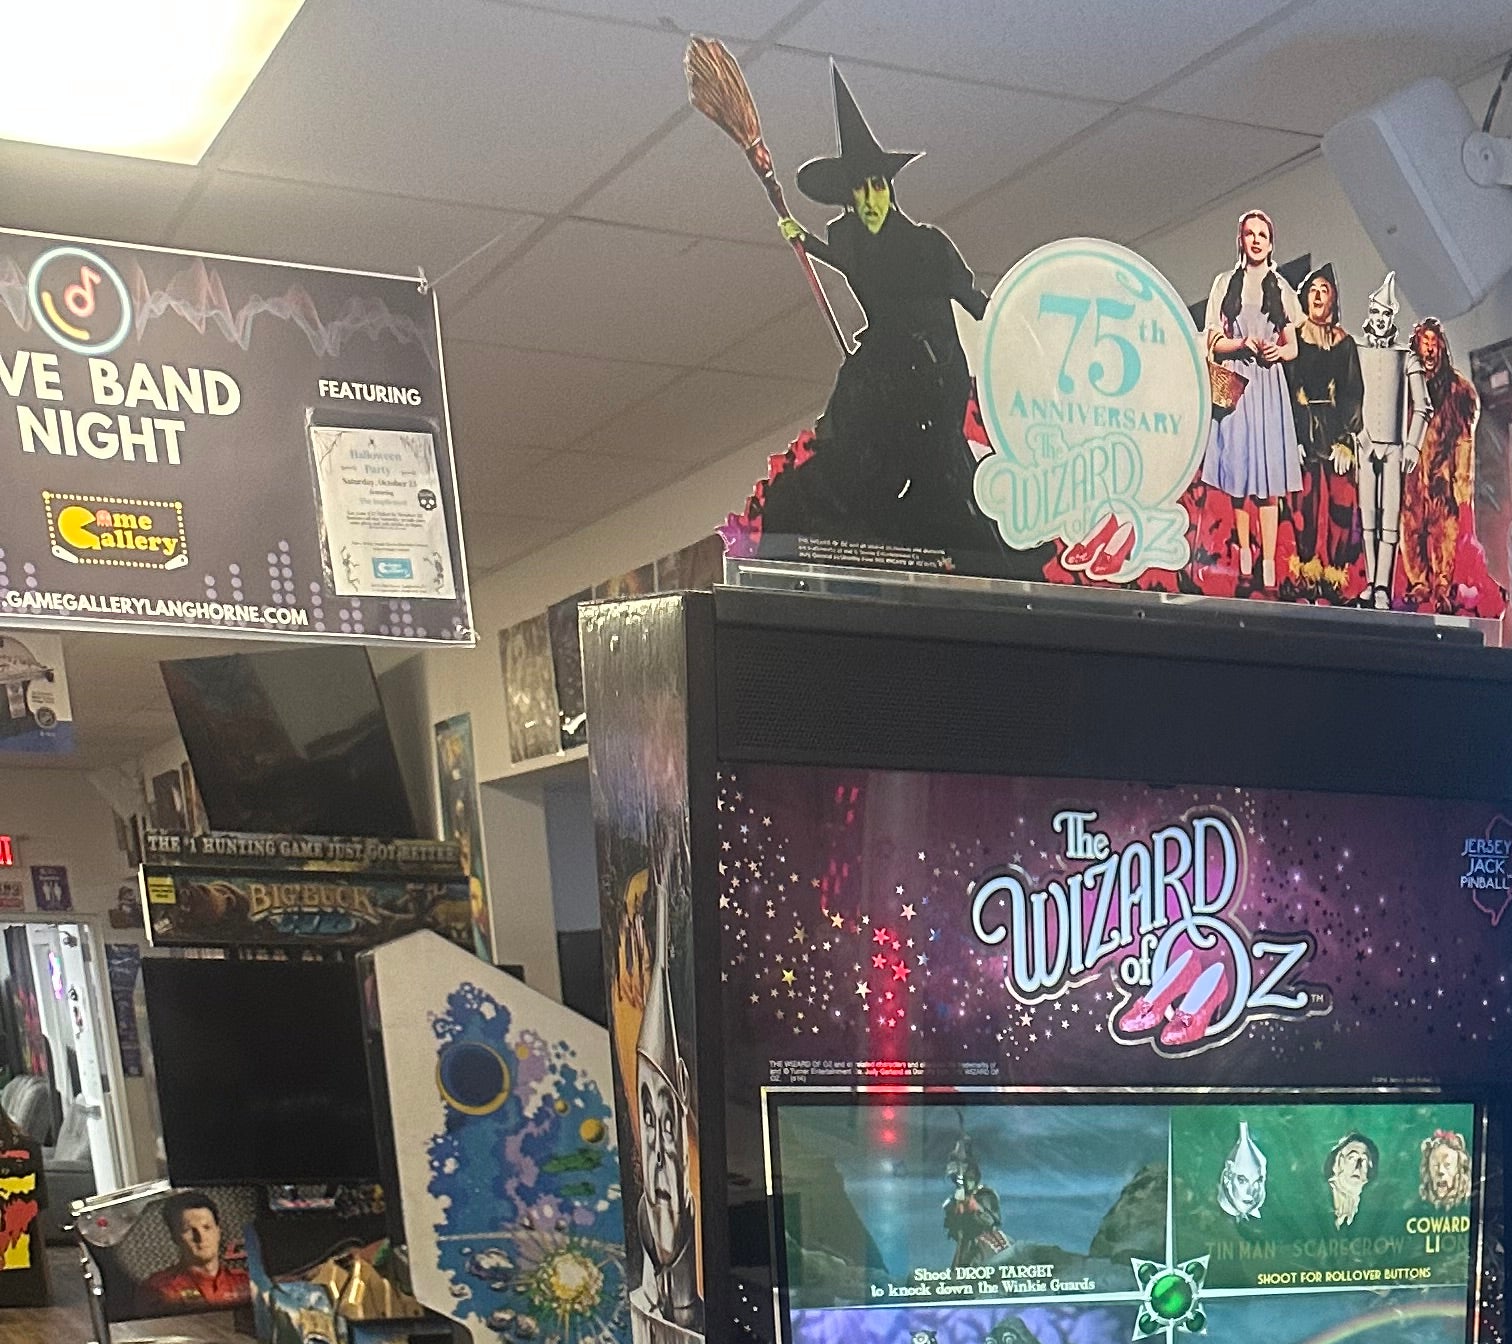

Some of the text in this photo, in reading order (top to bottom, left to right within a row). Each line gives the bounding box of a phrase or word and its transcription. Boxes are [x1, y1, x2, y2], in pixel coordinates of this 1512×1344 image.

[1038, 293, 1167, 398] 75th
[89, 358, 241, 416] BAND
[318, 379, 422, 406] FEATURING
[1010, 389, 1183, 435] ANNIVERSARY
[17, 406, 186, 465] NIGHT
[989, 444, 1137, 533] WIZARD
[6, 590, 309, 627] GAMEGALLERYLANGHORNE.COM
[148, 835, 181, 852] THE
[201, 837, 276, 857] HUNTING
[280, 840, 321, 858] GAME
[327, 842, 363, 859] JUST
[1052, 811, 1111, 860] The
[1460, 838, 1512, 857] JERSEY
[1466, 857, 1506, 877] JACK
[1460, 875, 1510, 890] PINBALL
[249, 883, 298, 914] BIG
[972, 816, 1239, 993] WIZARD
[1120, 914, 1309, 1037] of Oz
[1406, 1215, 1471, 1235] COWARD
[1206, 1241, 1233, 1260] TIN
[1239, 1240, 1276, 1259] MAN
[870, 1277, 1096, 1297] to knock down the Winkie Guards
[914, 1264, 1055, 1281] Shoot DROP TARGET
[1257, 1266, 1432, 1285] SHOOT FOR ROLLOVER BUTTONS
